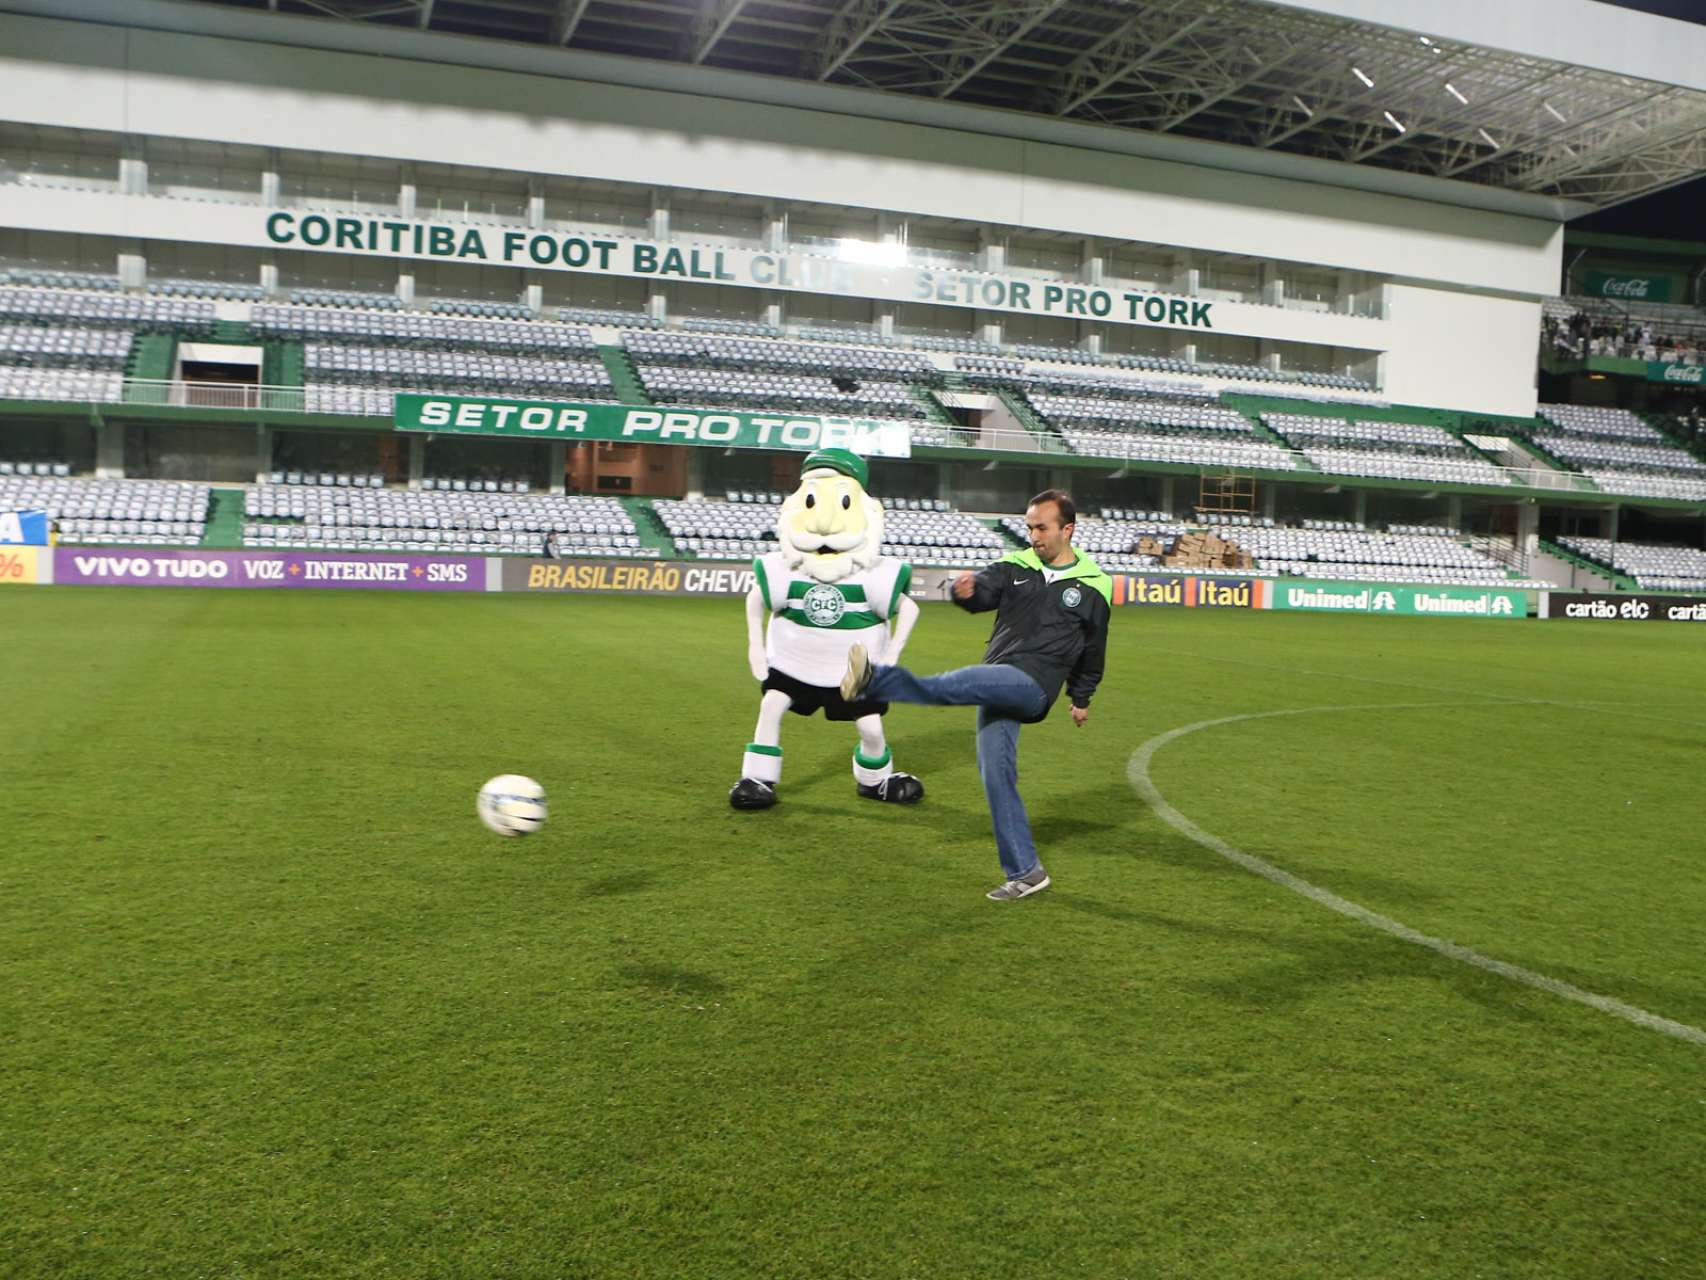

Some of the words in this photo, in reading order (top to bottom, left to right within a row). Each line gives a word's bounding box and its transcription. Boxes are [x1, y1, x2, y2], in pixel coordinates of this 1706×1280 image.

[266, 212, 488, 260] CORITIBA
[503, 232, 618, 270] FOOT
[632, 244, 736, 281] BALL
[912, 271, 1031, 309] SETOR
[1043, 285, 1112, 317] PRO
[1124, 294, 1213, 327] TORK
[419, 401, 588, 434] SETOR
[621, 410, 739, 441] PRO
[74, 556, 150, 577] VIVO
[154, 558, 228, 578] TUDO
[243, 559, 284, 579] VOZ
[304, 561, 408, 581] INTERNET
[427, 563, 468, 583] SMS
[528, 561, 680, 592] BRASILEIRÃO
[1128, 577, 1181, 604] Itaú
[1199, 579, 1249, 607] Itaú
[1288, 588, 1369, 610] Unimed
[1414, 593, 1488, 614] Unimed
[1565, 600, 1617, 619] cartão
